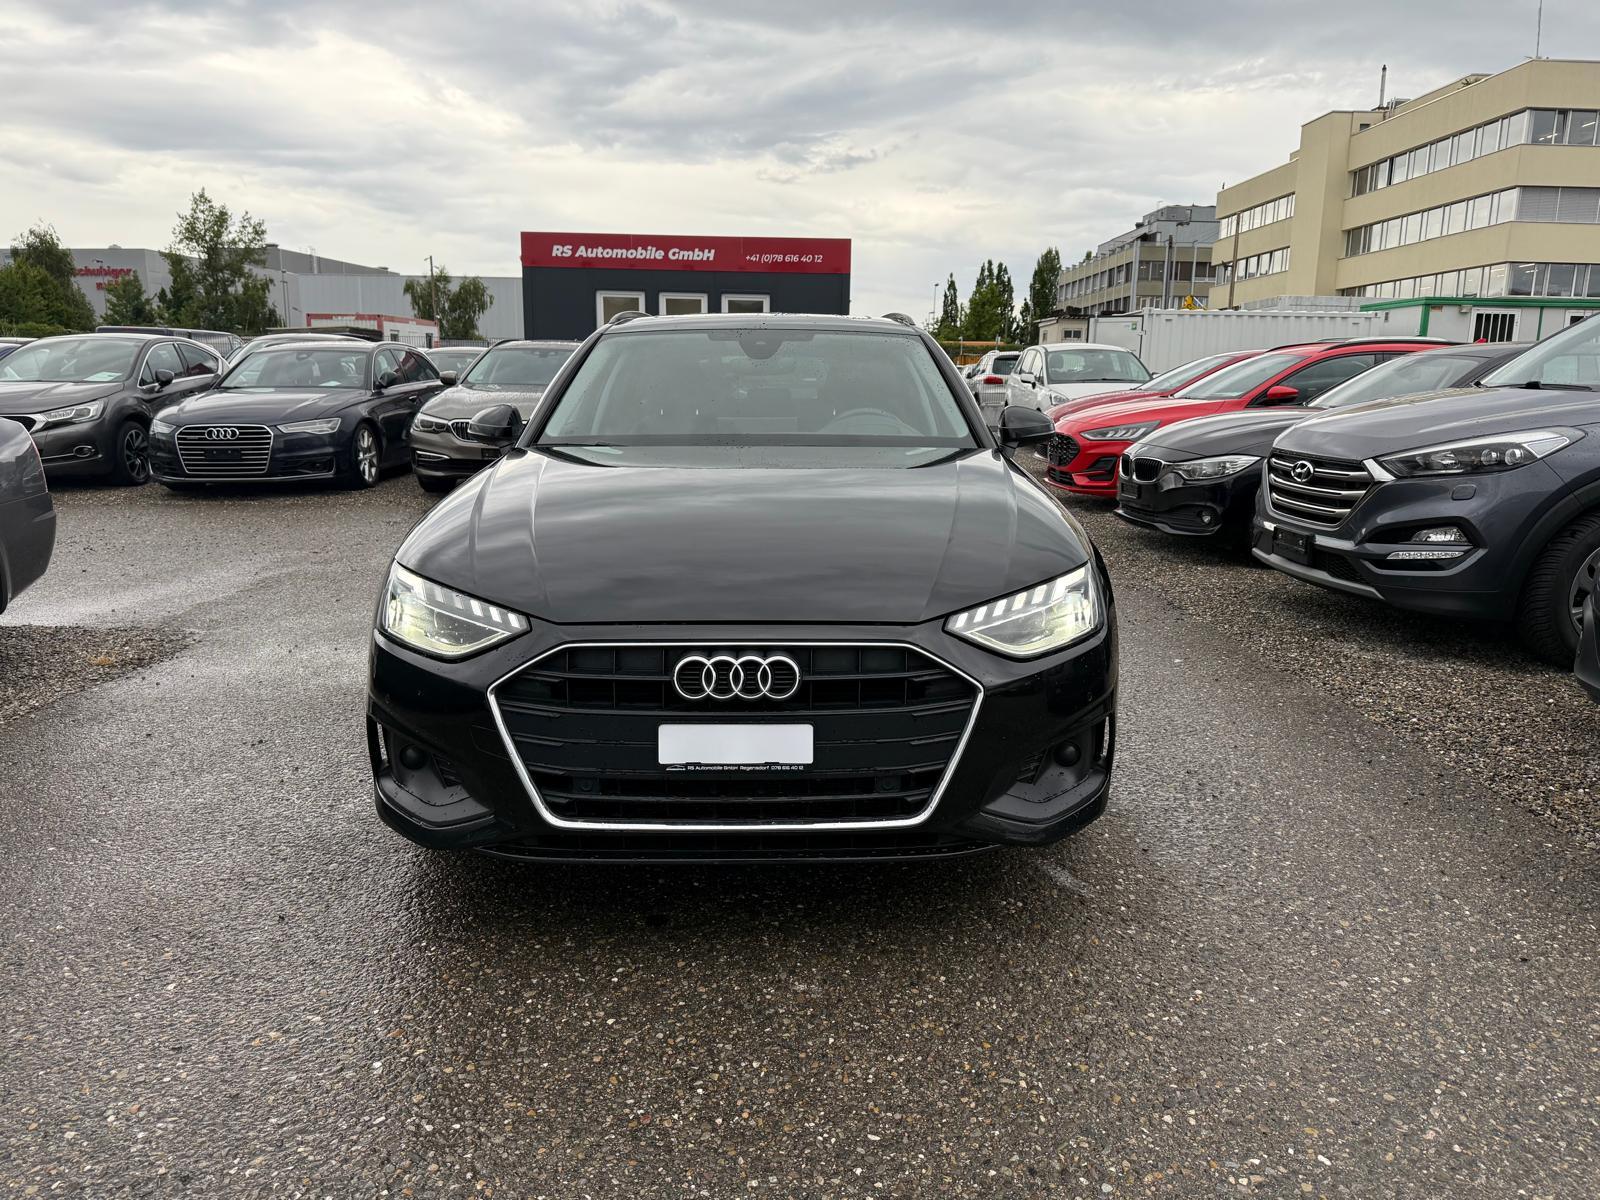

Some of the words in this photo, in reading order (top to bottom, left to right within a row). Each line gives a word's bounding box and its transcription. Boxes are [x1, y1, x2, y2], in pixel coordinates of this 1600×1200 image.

[551, 244, 573, 257] RS
[575, 245, 665, 260] Automobile
[668, 247, 716, 261] GmbH
[745, 254, 760, 262] +41
[761, 253, 784, 264] (0)78
[785, 254, 799, 262] 616
[800, 254, 813, 262] 40
[814, 254, 823, 262] 12
